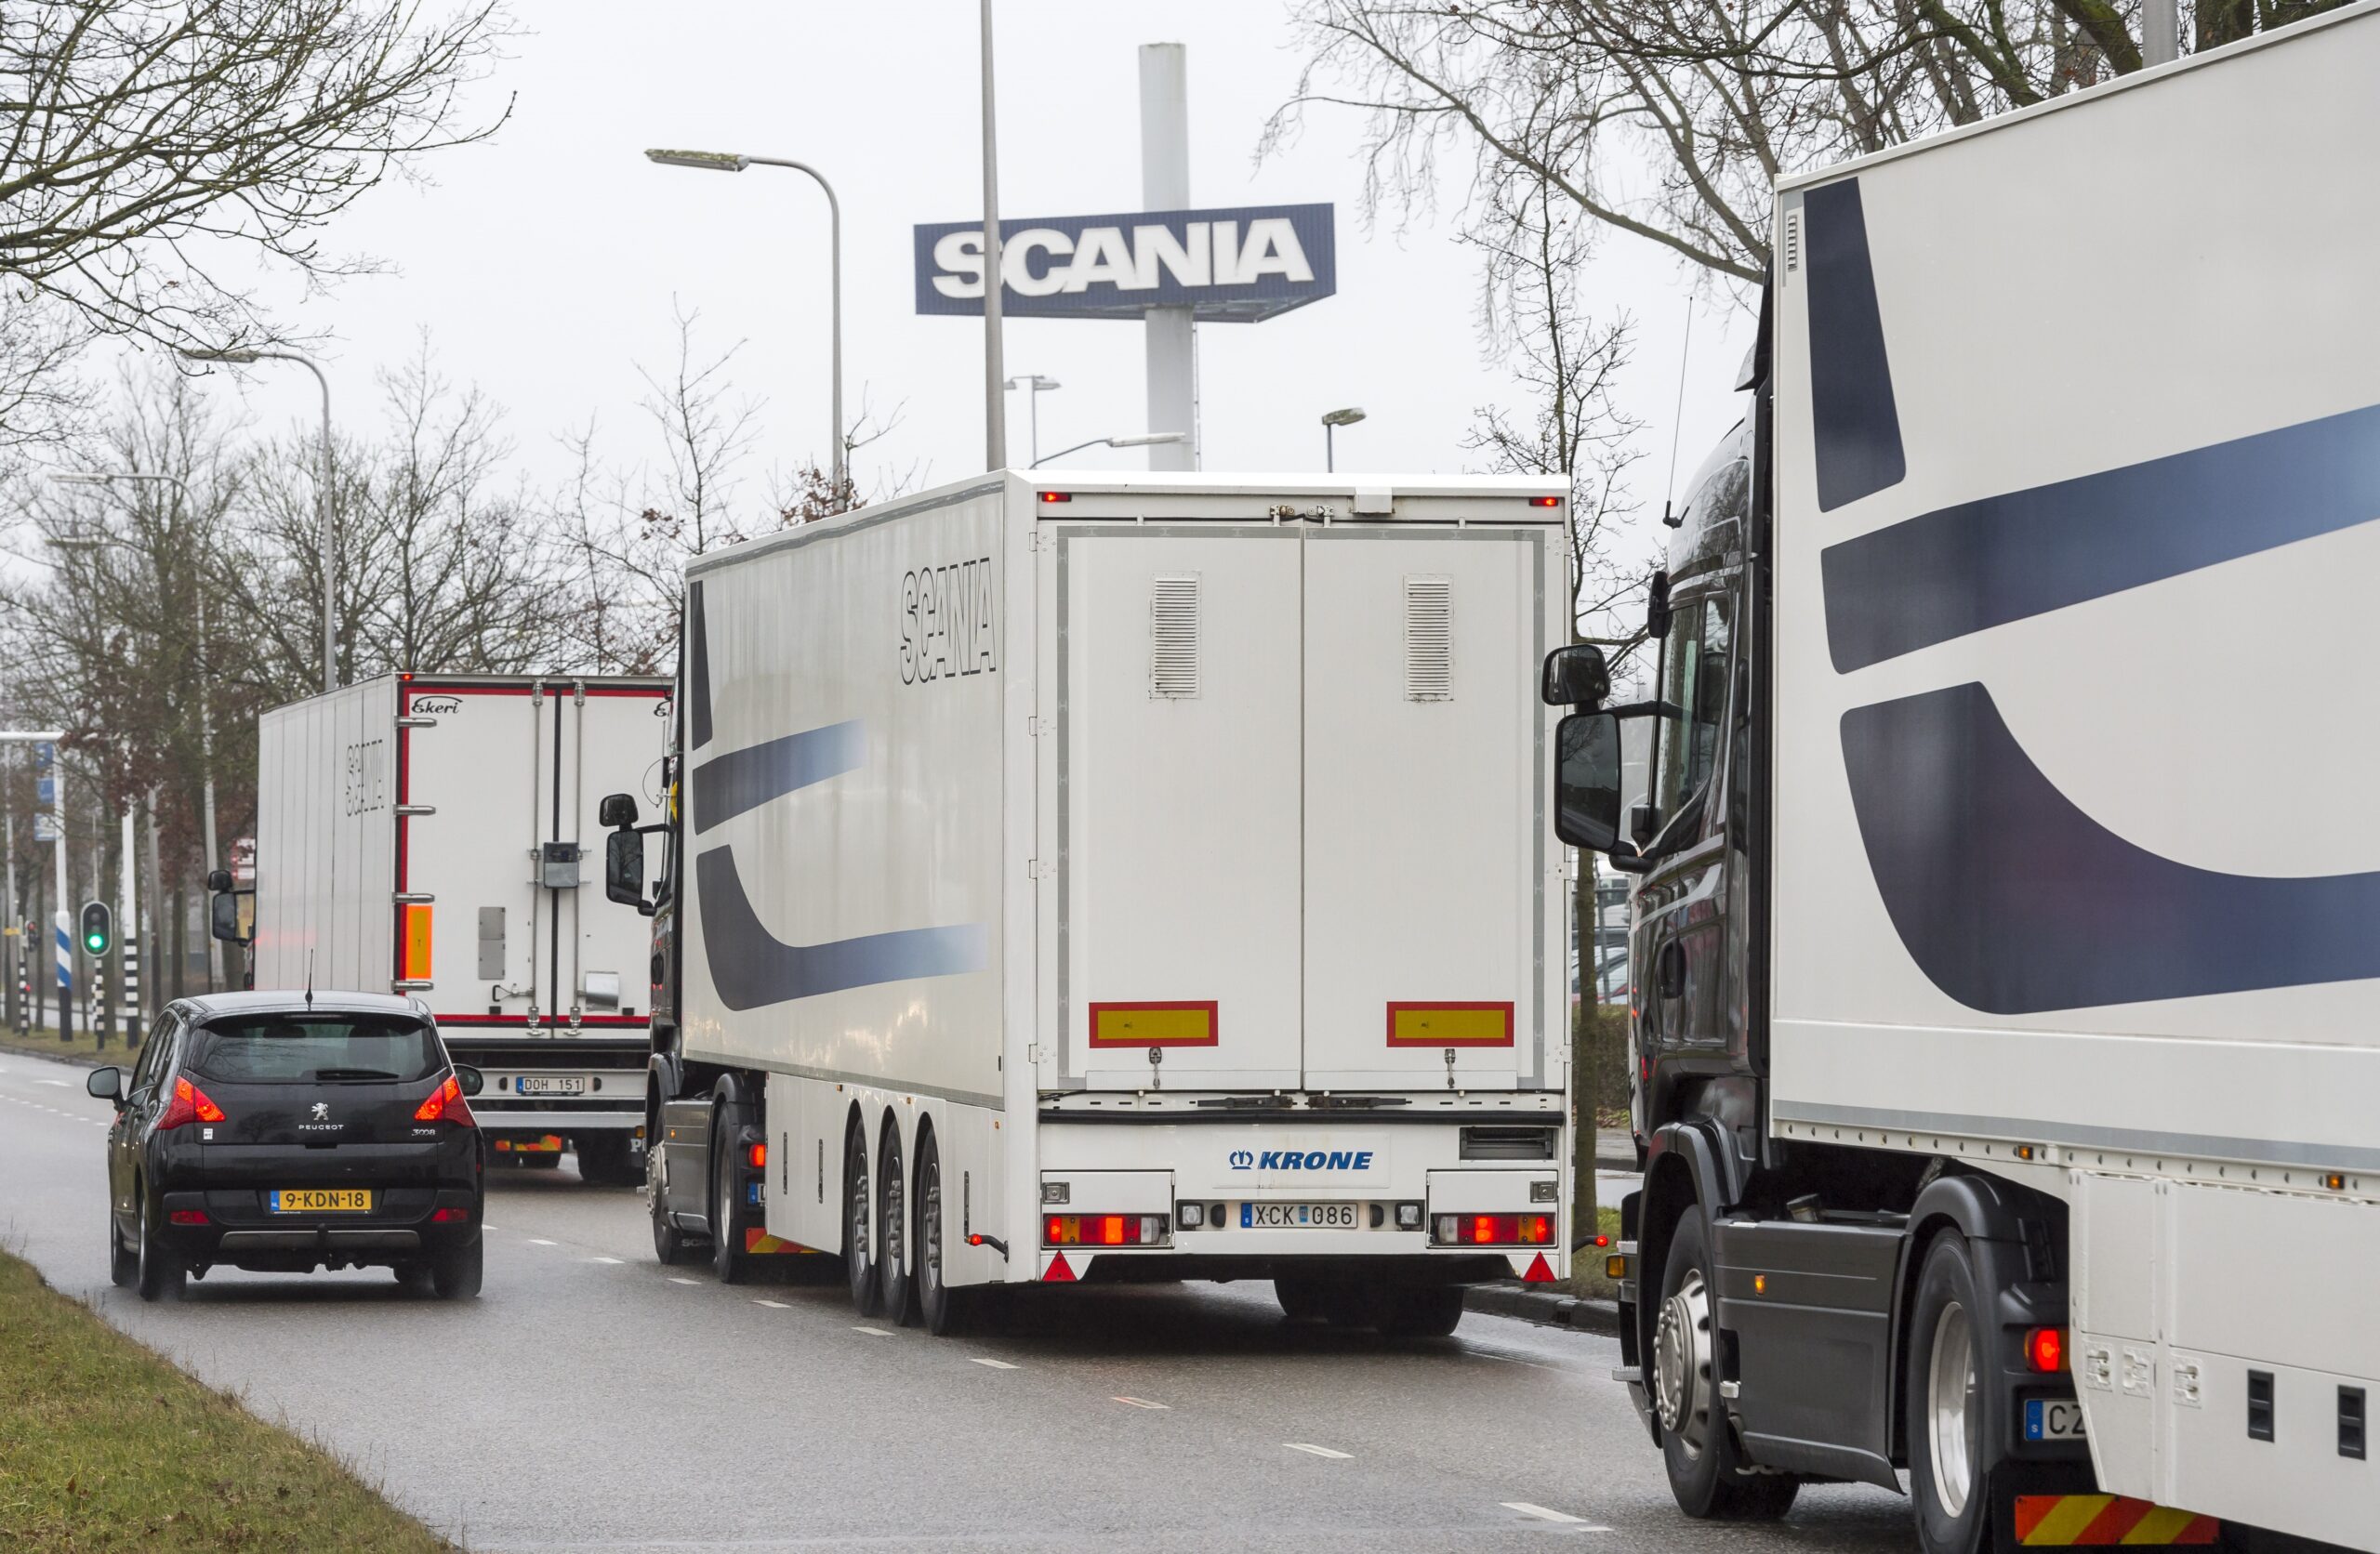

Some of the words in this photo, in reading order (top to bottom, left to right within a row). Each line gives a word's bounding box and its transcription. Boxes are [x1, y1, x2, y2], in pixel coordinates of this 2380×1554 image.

[932, 217, 1316, 298] SCANIA
[900, 557, 997, 685] SCANIA
[411, 695, 463, 714] Ekeri
[654, 700, 670, 717] E
[346, 739, 384, 817] SCANIA
[524, 1079, 549, 1090] DOH
[560, 1079, 581, 1090] 151
[411, 1128, 436, 1137] 3008
[1260, 1152, 1373, 1170] KRONE
[285, 1192, 364, 1208] 9-KDN-18
[1256, 1205, 1294, 1225] XCK
[1312, 1205, 1353, 1225] 086
[2030, 1424, 2039, 1433] S
